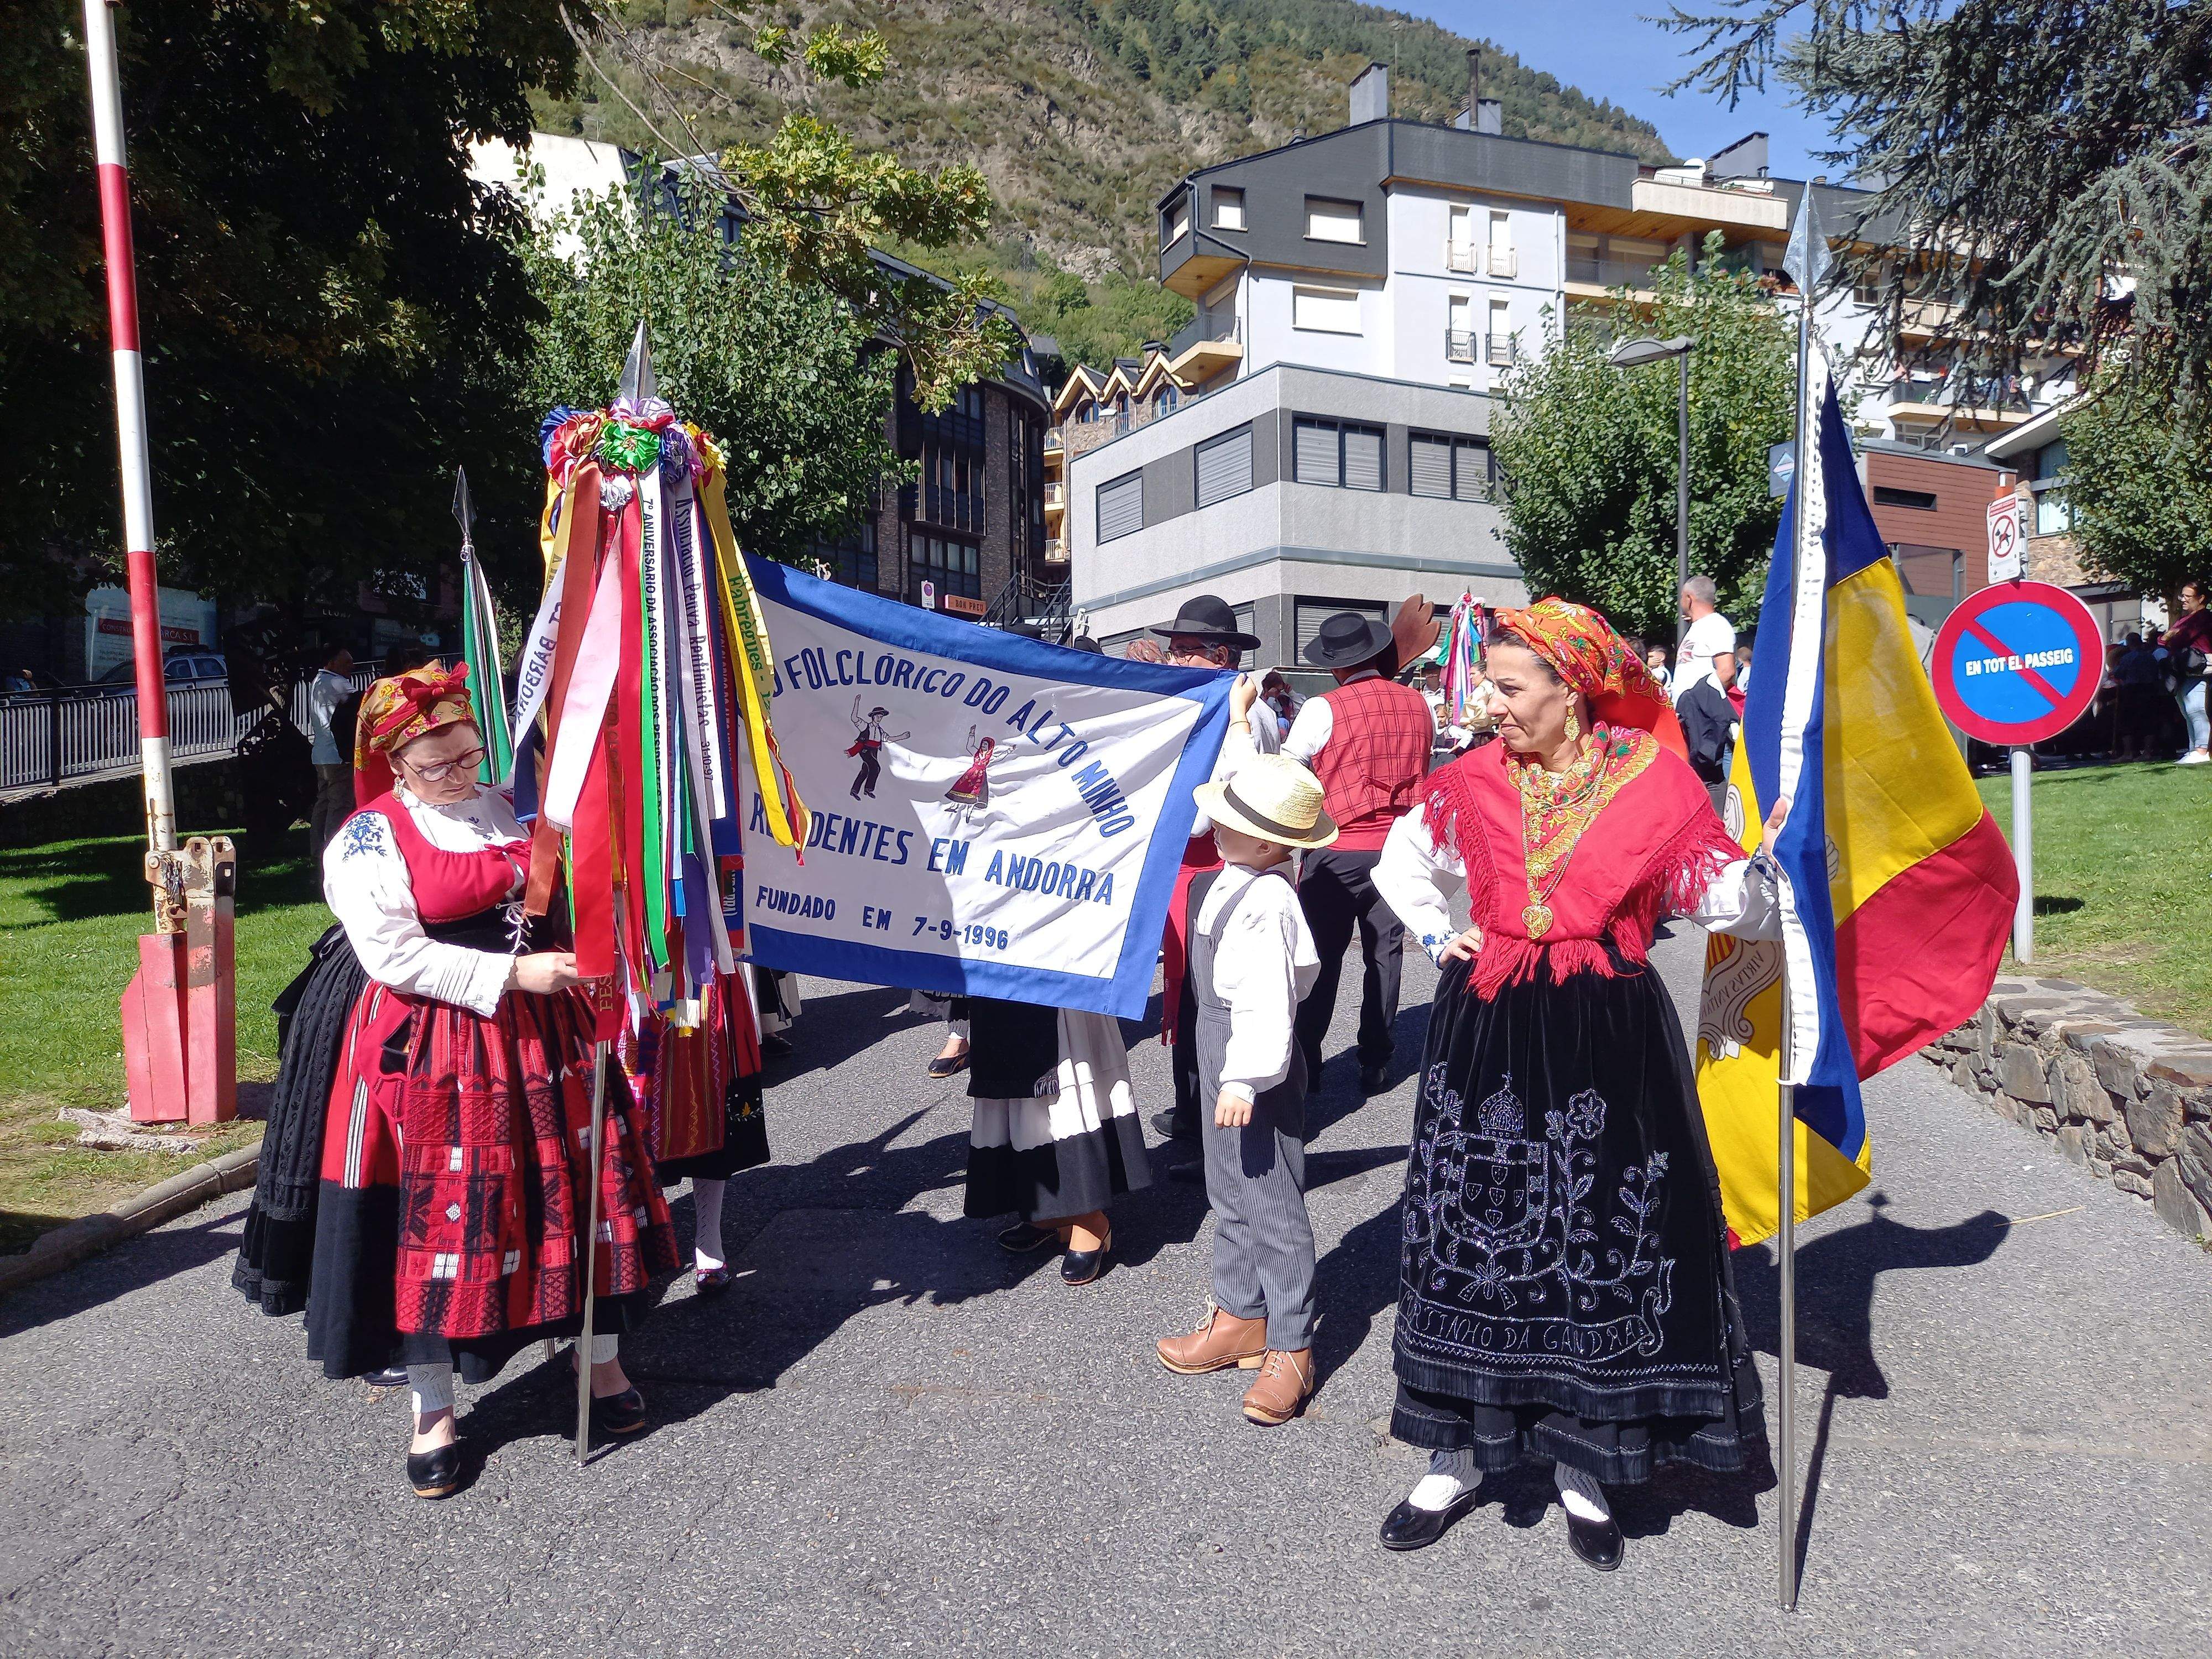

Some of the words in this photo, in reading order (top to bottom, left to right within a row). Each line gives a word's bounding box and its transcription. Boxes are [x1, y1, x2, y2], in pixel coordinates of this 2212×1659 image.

[643, 513, 656, 593] ANIVERSARIO
[646, 597, 656, 612] DA
[955, 599, 967, 609] BON
[1965, 660, 1981, 676] EN
[1983, 656, 2007, 674] TOT
[2008, 655, 2023, 671] EL
[2025, 648, 2074, 669] PASSEIG
[701, 741, 713, 781] 31-10-97
[783, 647, 964, 696] FOLCLÓRICO
[965, 677, 1010, 714] DO
[1006, 700, 1088, 768] ALTO
[1072, 760, 1135, 837] MINHO
[750, 792, 914, 865] RDENTES
[927, 838, 969, 875] EM
[985, 850, 1113, 905] ANDORRA
[756, 886, 836, 920] FUNDADO
[863, 905, 891, 930] EM
[912, 916, 1008, 950] 7-9-1996
[1503, 1325, 1531, 1350] DA
[1543, 1319, 1636, 1357] GANDRA
